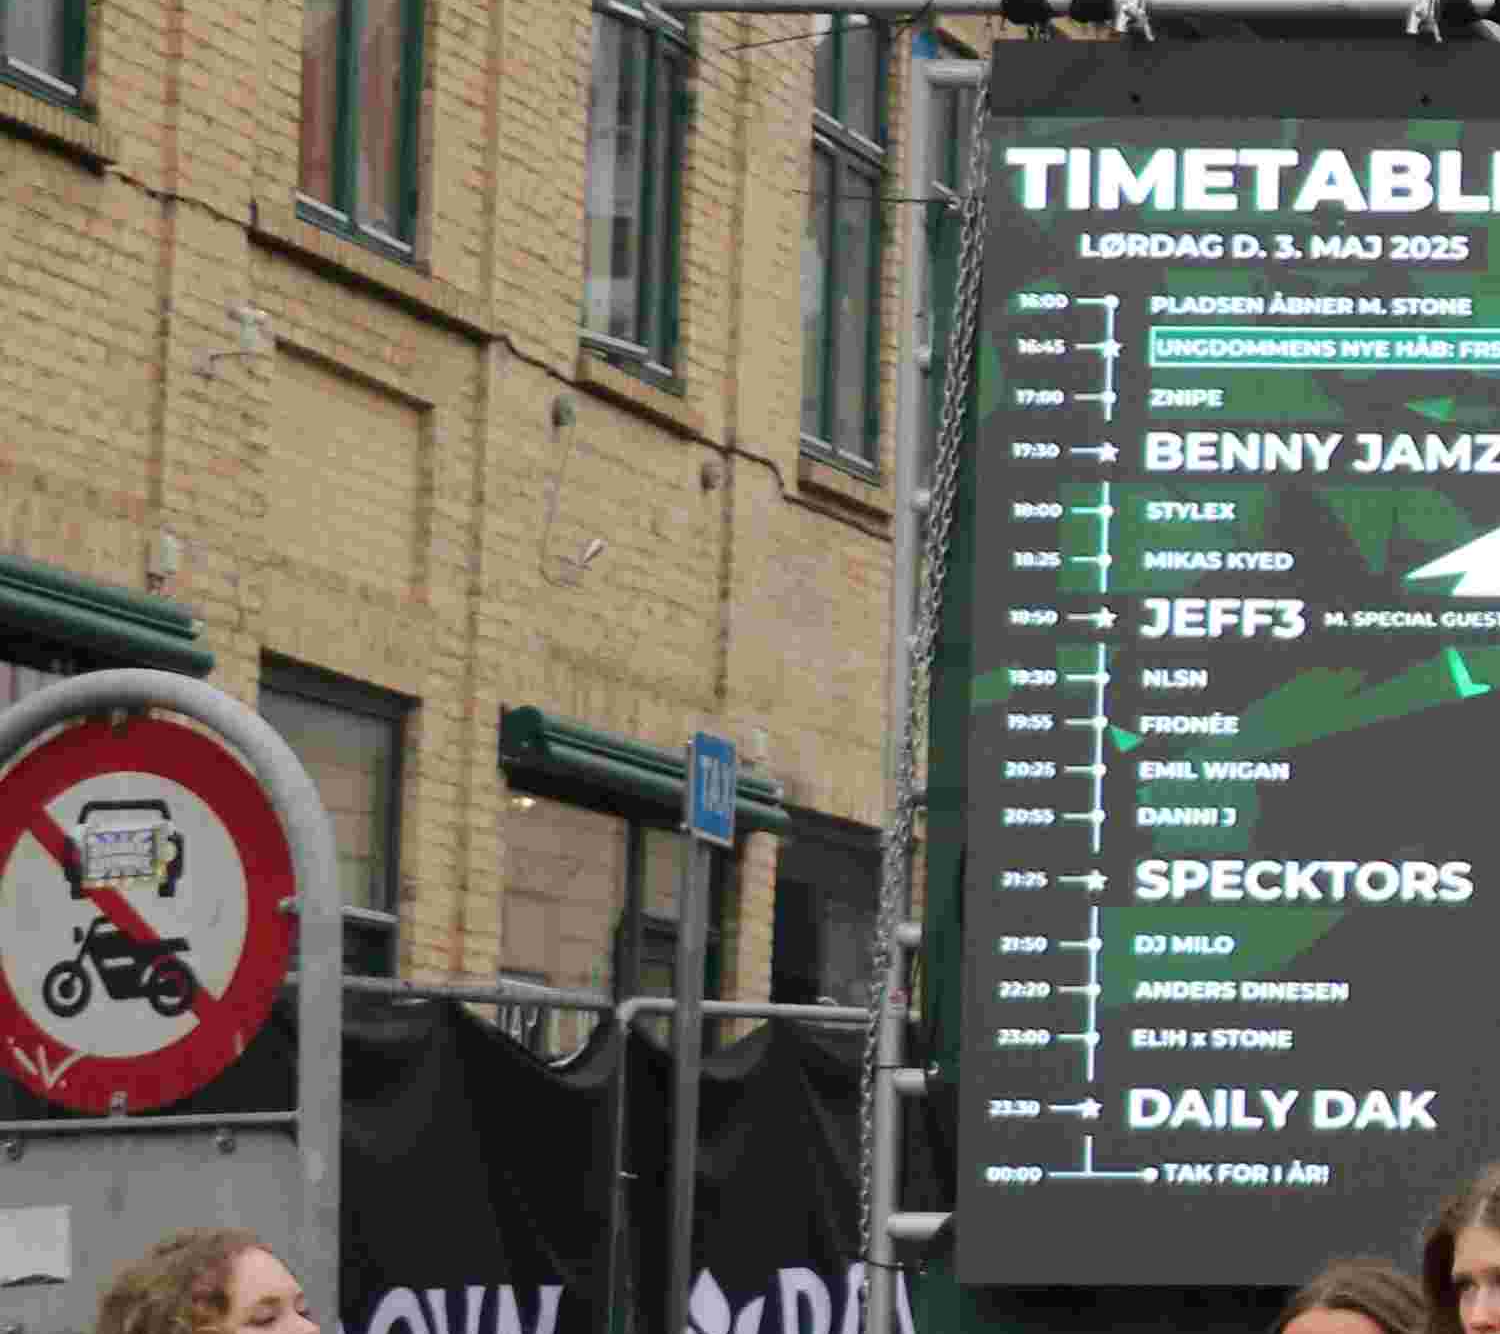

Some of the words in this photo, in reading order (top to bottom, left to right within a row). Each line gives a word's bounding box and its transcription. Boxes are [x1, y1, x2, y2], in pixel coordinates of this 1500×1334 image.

[1080, 232, 1224, 260] LØRDAG
[1231, 233, 1268, 259] D.
[1273, 234, 1303, 260] 3.
[1310, 234, 1383, 260] MAJ
[1389, 235, 1469, 261] 2025
[1151, 295, 1265, 315] PLADSEN
[1268, 291, 1354, 316] ÅBNER
[1357, 297, 1388, 316] M.
[1391, 297, 1473, 316] STONE
[1153, 338, 1337, 358] UNGDOMMENS
[1340, 340, 1391, 358] NYE
[1149, 388, 1223, 407] ZNIPE
[1145, 431, 1343, 472] BENNY
[1147, 501, 1235, 521] STYLEX
[1144, 551, 1223, 570] MIKAS
[1226, 551, 1294, 571] KYED
[1140, 598, 1306, 639] JEFF3
[1324, 611, 1348, 627] M.
[1352, 610, 1438, 628] SPECIAL
[1142, 669, 1208, 688] NLSN
[1139, 711, 1240, 735] FRONÉE
[1139, 760, 1198, 780] EMIL
[1203, 761, 1290, 781] WIGAN
[1137, 807, 1218, 825] DANNI
[1222, 807, 1237, 827] J
[1135, 859, 1473, 902] SPECKTORS
[1135, 935, 1166, 953] DJ
[1171, 935, 1235, 954] MILO
[1135, 980, 1237, 1000] ANDERS
[1240, 981, 1349, 1001] DINESEN
[1211, 1028, 1293, 1049] STONE
[1128, 1088, 1299, 1129] DAILY
[1313, 1089, 1437, 1129] DAK
[1164, 1163, 1213, 1183] TAK
[1217, 1163, 1269, 1183] FOR
[1286, 1159, 1330, 1185] ÅR!
